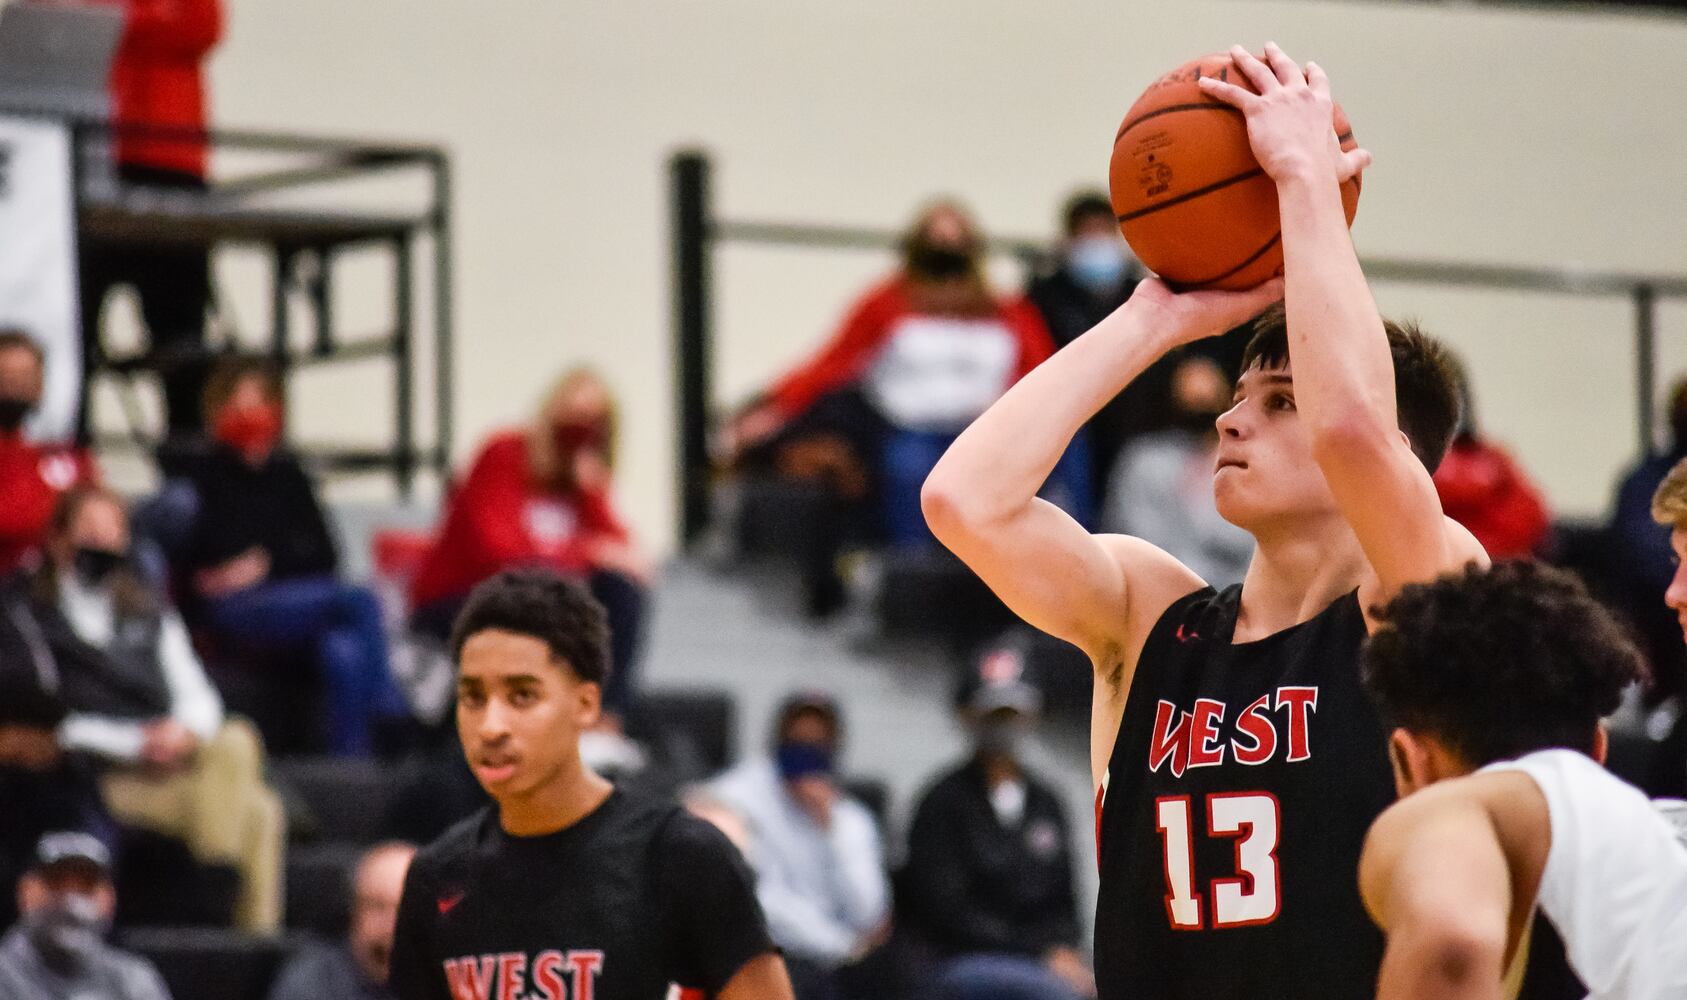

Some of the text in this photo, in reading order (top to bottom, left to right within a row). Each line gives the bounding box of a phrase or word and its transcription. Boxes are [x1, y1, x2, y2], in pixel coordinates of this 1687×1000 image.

[1149, 686, 1319, 779] WEST
[1155, 791, 1282, 931] 13
[443, 949, 605, 1000] WEST
